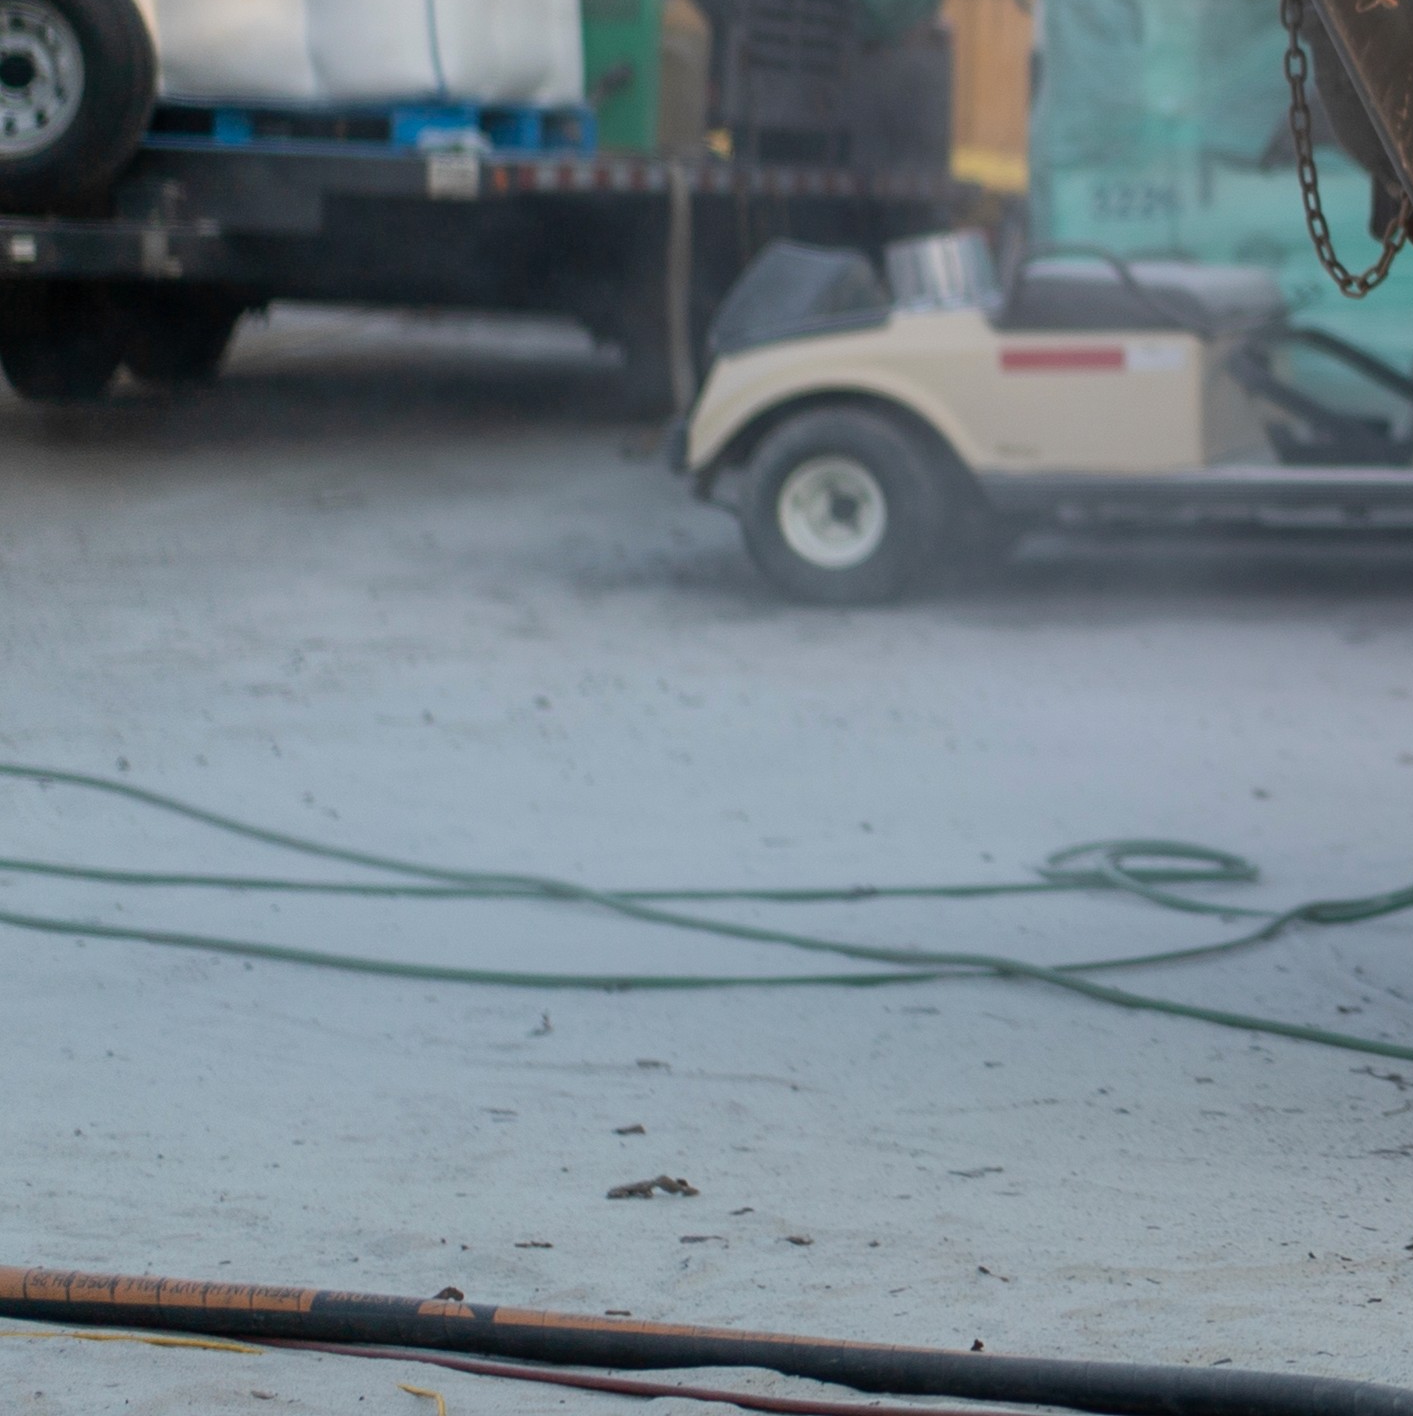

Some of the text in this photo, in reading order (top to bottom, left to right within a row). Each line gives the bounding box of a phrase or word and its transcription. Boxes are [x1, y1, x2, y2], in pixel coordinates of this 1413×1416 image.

[76, 1275, 119, 1292] HOSE
[126, 1277, 168, 1294] WALL
[171, 1281, 221, 1296] HEAVY
[225, 1285, 300, 1300] PREMIUM
